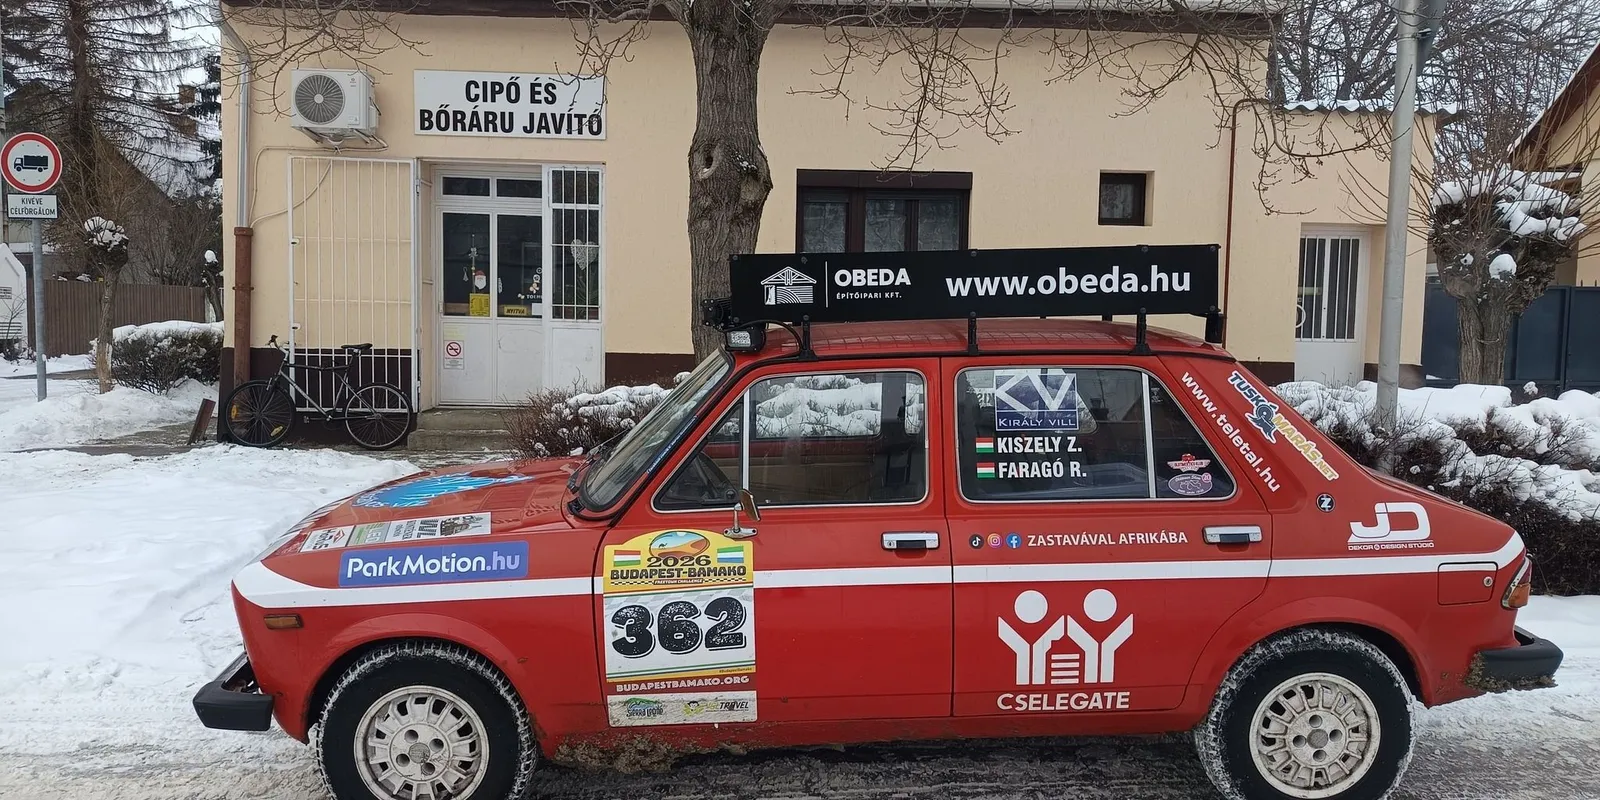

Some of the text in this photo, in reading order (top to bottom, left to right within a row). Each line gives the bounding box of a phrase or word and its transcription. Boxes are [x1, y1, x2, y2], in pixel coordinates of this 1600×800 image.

[465, 76, 557, 105] CIPŐ ÉS
[419, 105, 603, 136] BŐRÁRU JAVÍTÓ
[21, 197, 43, 206] KIVÉVE
[834, 268, 911, 287] OBEDA
[945, 265, 1191, 297] www.obeda.hu
[998, 416, 1076, 427] KIRÁLY VILL
[1181, 372, 1280, 492] www.teletal.hu
[997, 436, 1083, 453] KISZELY Z.
[998, 458, 1087, 478] FARAGÓ R.
[1027, 530, 1188, 547] ZASTAVÁVAL AFRIKÁBA
[347, 551, 520, 578] ParkMotion.hu
[646, 554, 711, 568] 2026
[610, 565, 747, 580] BUDAPEST-BAMAKO
[610, 596, 747, 659] 362
[616, 675, 750, 692] BUDAPESTBAMAKO.ORG
[996, 691, 1131, 711] CSELEGATE
